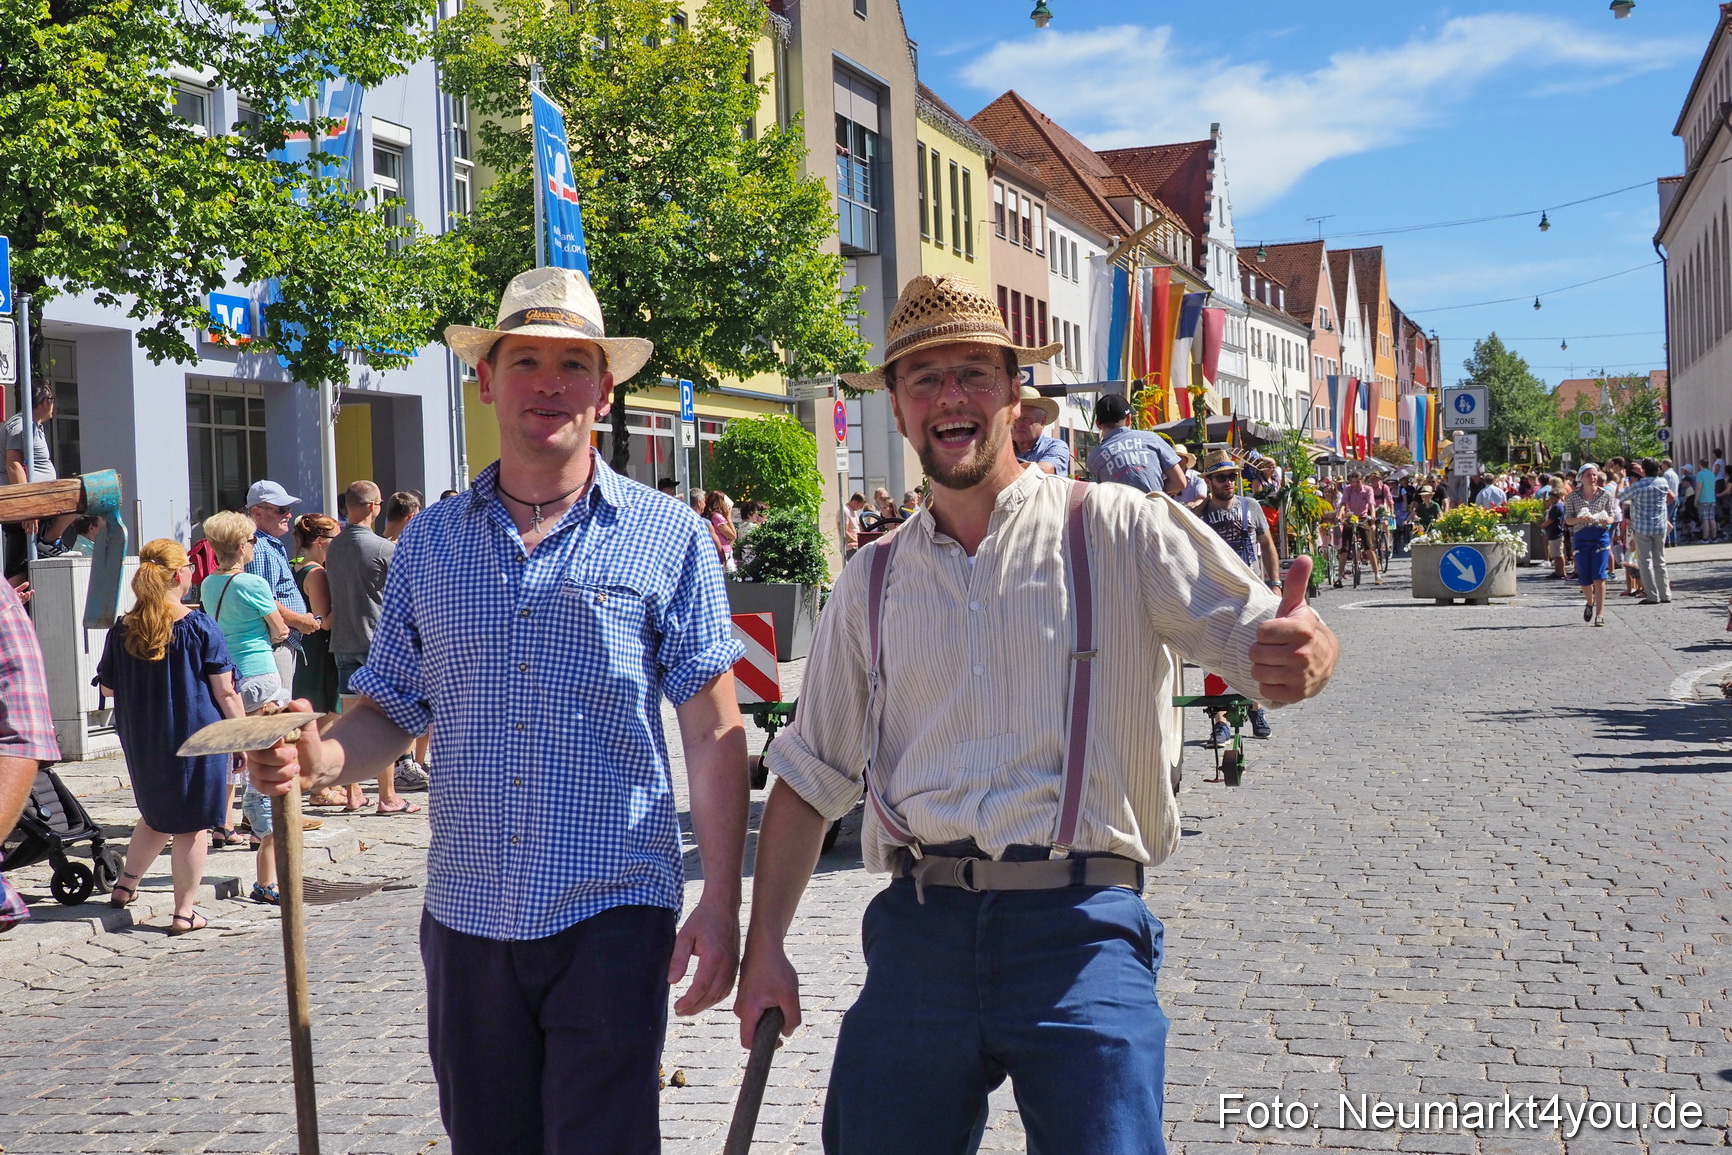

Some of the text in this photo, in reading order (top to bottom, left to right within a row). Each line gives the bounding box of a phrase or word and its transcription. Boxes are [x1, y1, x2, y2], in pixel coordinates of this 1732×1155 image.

[683, 385, 691, 417] P
[1100, 438, 1143, 462] BEACH
[1105, 451, 1150, 475] POINT
